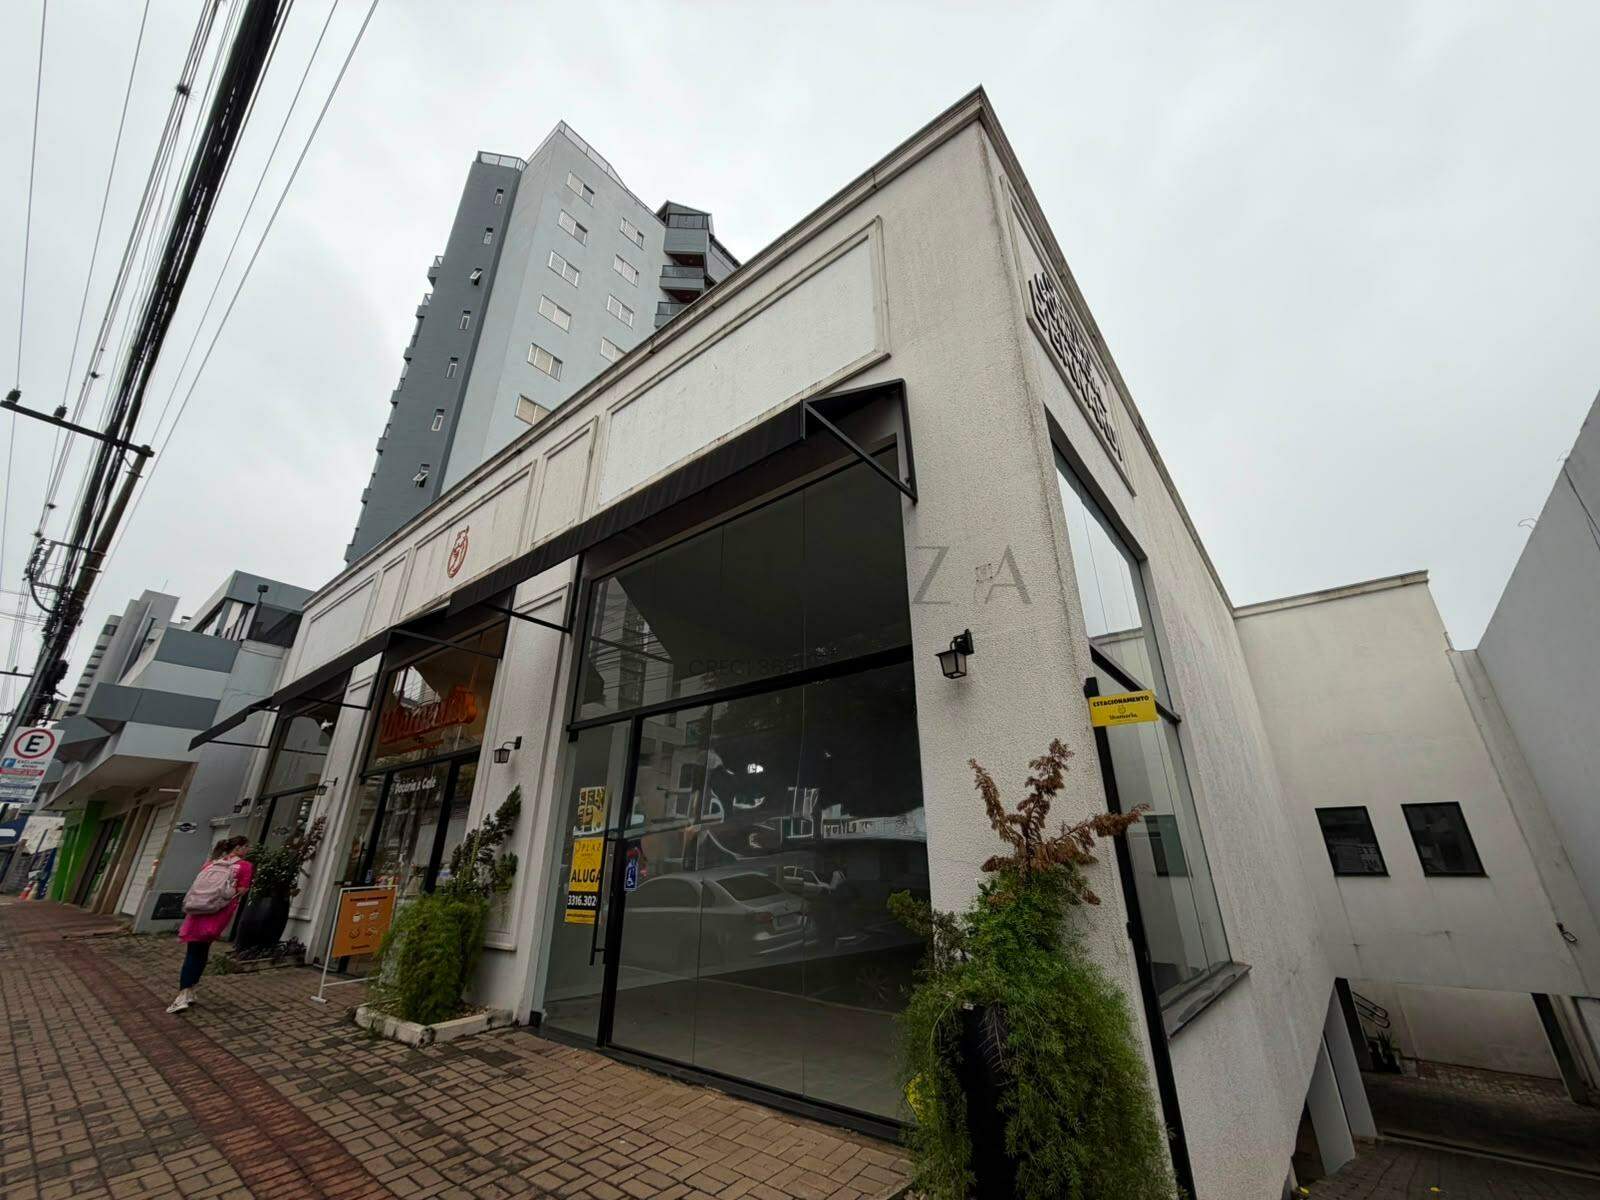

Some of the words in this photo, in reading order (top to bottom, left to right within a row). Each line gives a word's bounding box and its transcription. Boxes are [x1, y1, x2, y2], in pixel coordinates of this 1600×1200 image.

[1093, 695, 1150, 707] ESTACIONAMENTO
[24, 735, 44, 752] E
[571, 868, 601, 883] ALUGA
[567, 894, 598, 907] 3316.302
